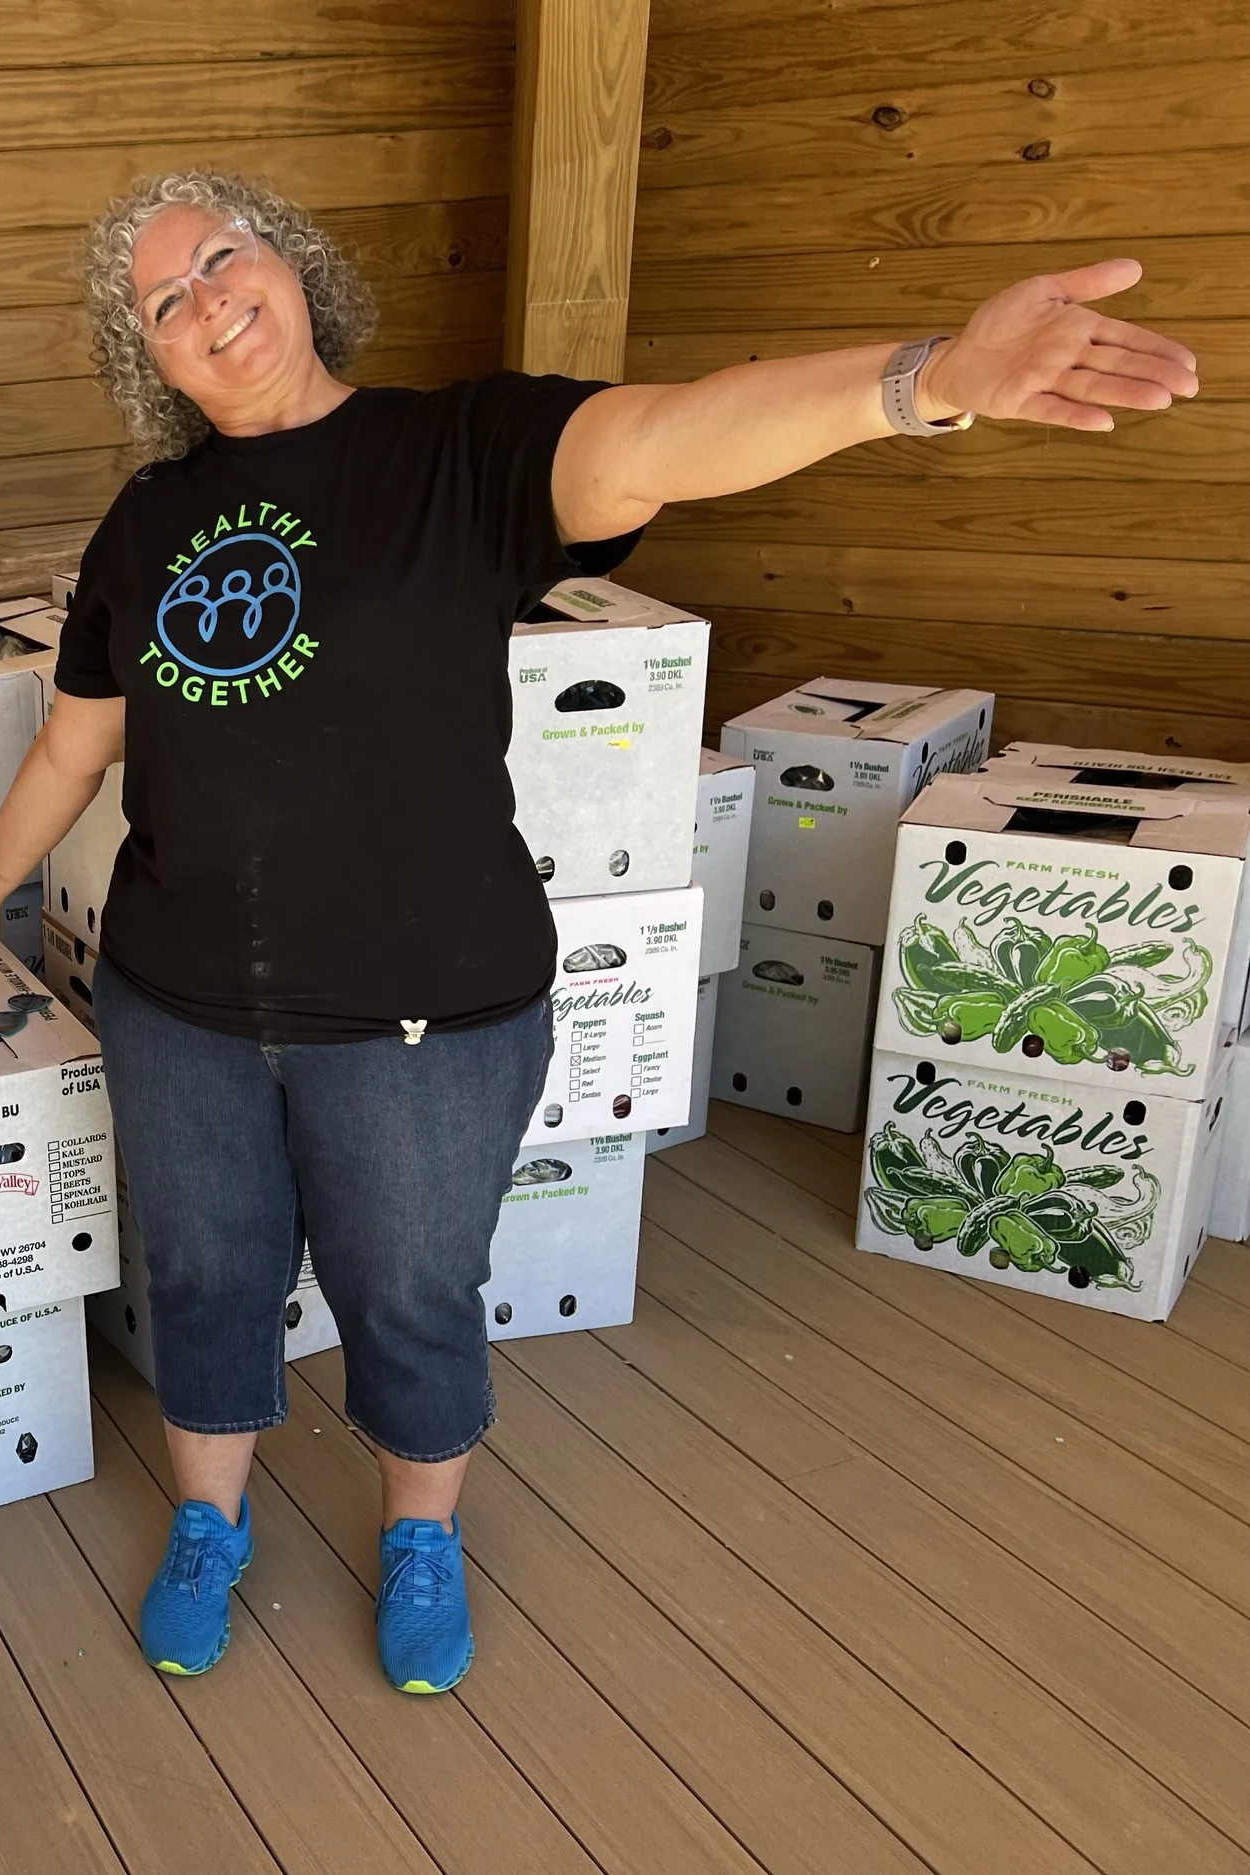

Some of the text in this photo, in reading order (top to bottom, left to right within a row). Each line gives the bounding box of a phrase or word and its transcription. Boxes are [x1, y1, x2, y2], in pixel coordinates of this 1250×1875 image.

[166, 501, 318, 575] HEALTHY
[139, 633, 320, 706] TOGETHER
[661, 656, 692, 668] Bushel
[519, 673, 547, 684] USA
[649, 669, 683, 681] 3.90 DKL
[542, 722, 645, 740] Grown Packed by
[1016, 796, 1146, 811] KEEP REFRIGERATED
[1033, 791, 1133, 805] PERISHABLE
[767, 796, 848, 816] Grown Packed by
[1006, 860, 1120, 881] FARM FRESH
[918, 860, 1207, 933] Vegetables
[658, 921, 687, 933] Bushel
[646, 934, 678, 945] 3.90 DKL
[634, 1010, 665, 1022] Squash
[572, 1019, 607, 1030] Peppers
[632, 1050, 669, 1063] Eggplant
[61, 1064, 104, 1080] Produce
[581, 1067, 601, 1075] Select
[61, 1079, 101, 1096] of USA
[967, 1079, 1074, 1107] FARM FRESH
[1, 1104, 20, 1118] BU
[886, 1074, 1155, 1160] Vegetables
[61, 1132, 107, 1148] COLLARDS
[61, 1147, 85, 1158] KALE
[62, 1154, 103, 1169] MUSTARD
[62, 1168, 86, 1179] TOPS
[63, 1177, 92, 1190] BEETS
[63, 1185, 101, 1200] SPINACH
[541, 1186, 590, 1199] Packed by
[64, 1195, 108, 1210] KOHLRABI
[0, 1247, 17, 1257] WV
[18, 1241, 47, 1254] 26704
[3, 1269, 14, 1279] of
[15, 1263, 44, 1277] U.S.A.
[20, 1313, 33, 1322] OF
[35, 1306, 62, 1319] U.S.A.
[14, 1382, 26, 1393] BY
